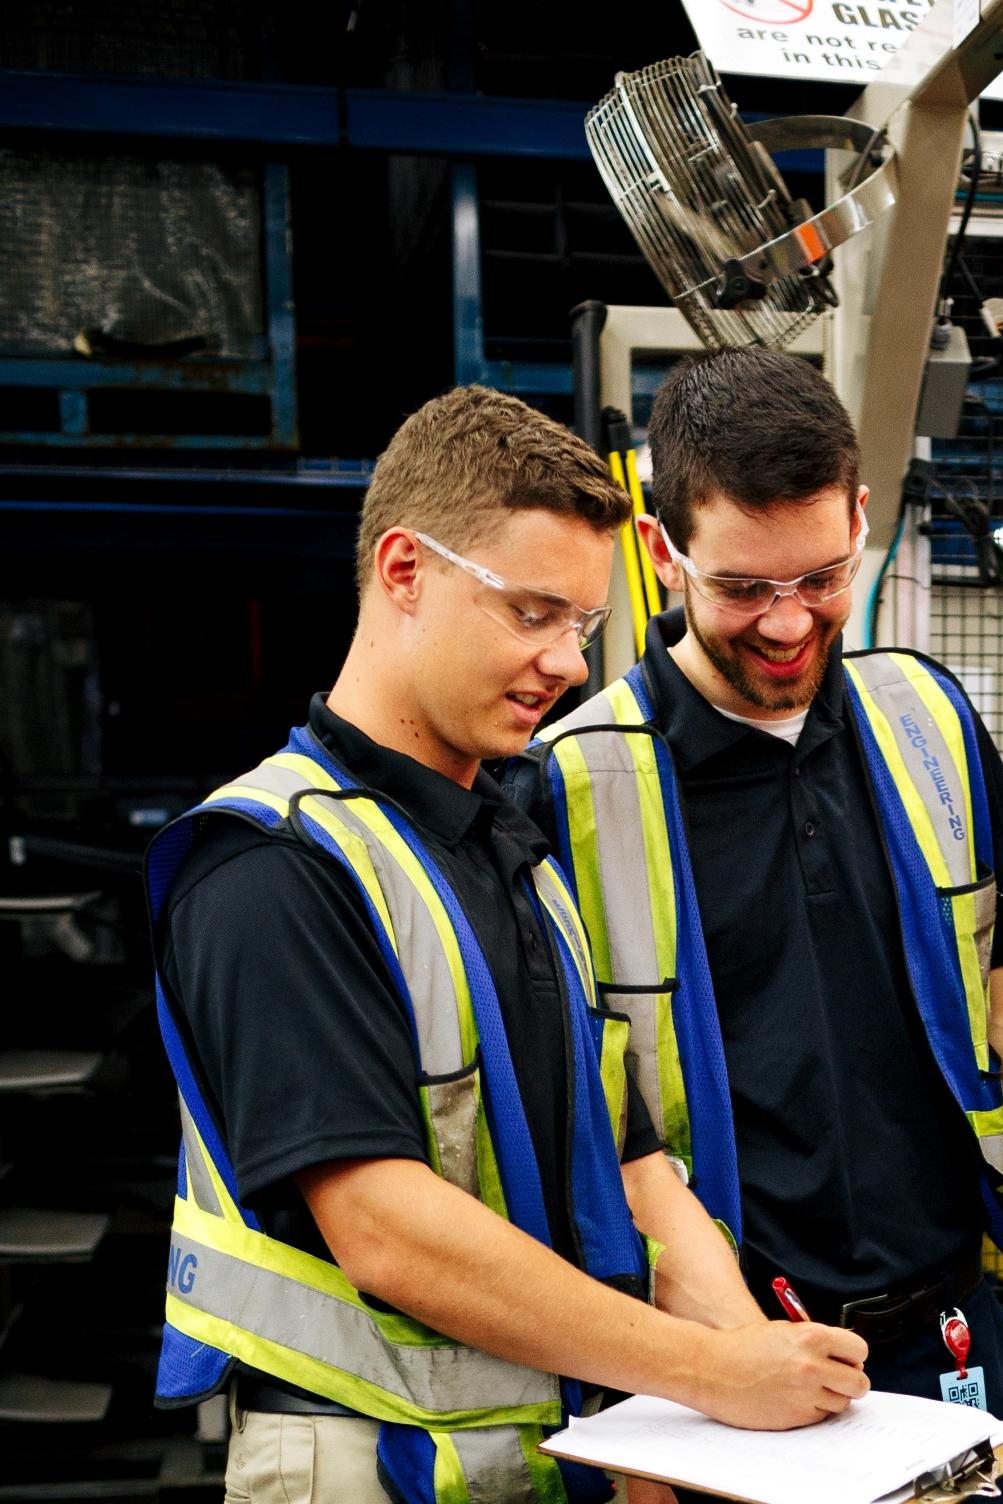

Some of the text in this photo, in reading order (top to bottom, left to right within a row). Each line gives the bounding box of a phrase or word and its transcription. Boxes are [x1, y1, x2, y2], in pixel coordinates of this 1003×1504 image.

[832, 3, 926, 31] GLAS
[737, 28, 897, 53] are not re
[781, 48, 881, 70] in this
[900, 713, 965, 841] ENGINEERING
